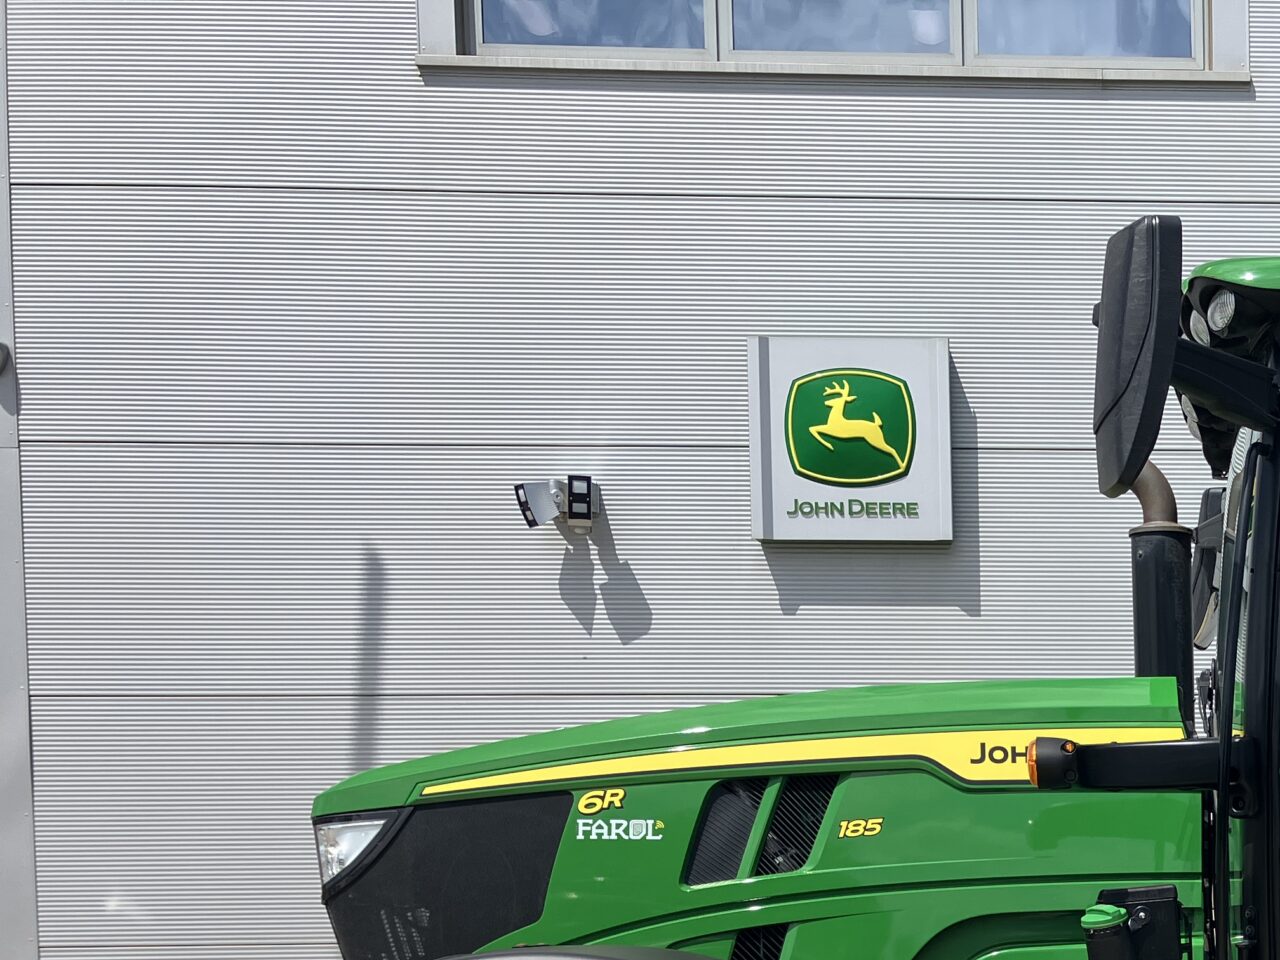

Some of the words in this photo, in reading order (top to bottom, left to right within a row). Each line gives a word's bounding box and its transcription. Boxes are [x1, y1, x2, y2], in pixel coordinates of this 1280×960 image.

[787, 499, 844, 518] JOHN
[848, 499, 919, 518] DEERE
[970, 742, 1028, 764] JOH
[577, 787, 626, 815] 6R
[576, 819, 663, 840] FAROL
[838, 817, 884, 839] 185
